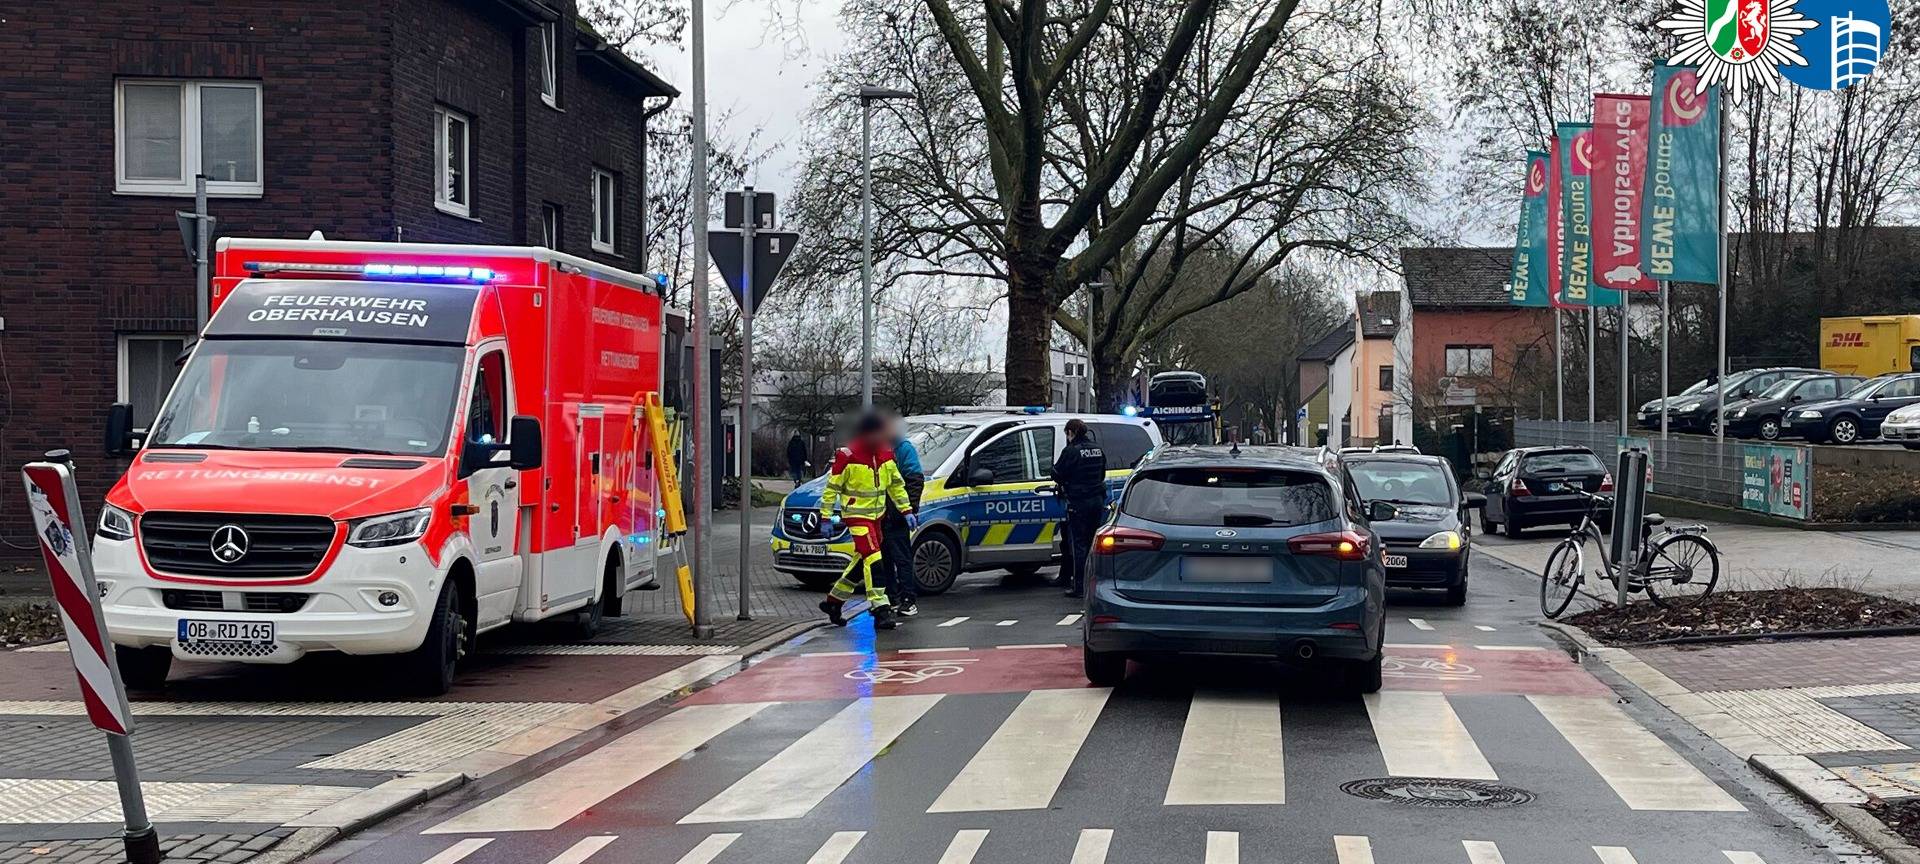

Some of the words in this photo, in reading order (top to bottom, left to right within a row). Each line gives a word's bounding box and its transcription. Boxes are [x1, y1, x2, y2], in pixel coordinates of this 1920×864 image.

[264, 295, 428, 311] FEUERWEHR
[247, 308, 429, 327] OBERHAUSEN
[1832, 332, 1864, 348] DHL
[1152, 406, 1203, 415] AICHINGER
[137, 469, 386, 489] RETTUNGSDIENST
[985, 500, 1045, 515] POLIZEI
[1182, 543, 1269, 551] FOCUS
[1385, 556, 1406, 566] 2006
[188, 622, 208, 638] OB
[217, 623, 238, 639] RD
[241, 624, 271, 639] 165
